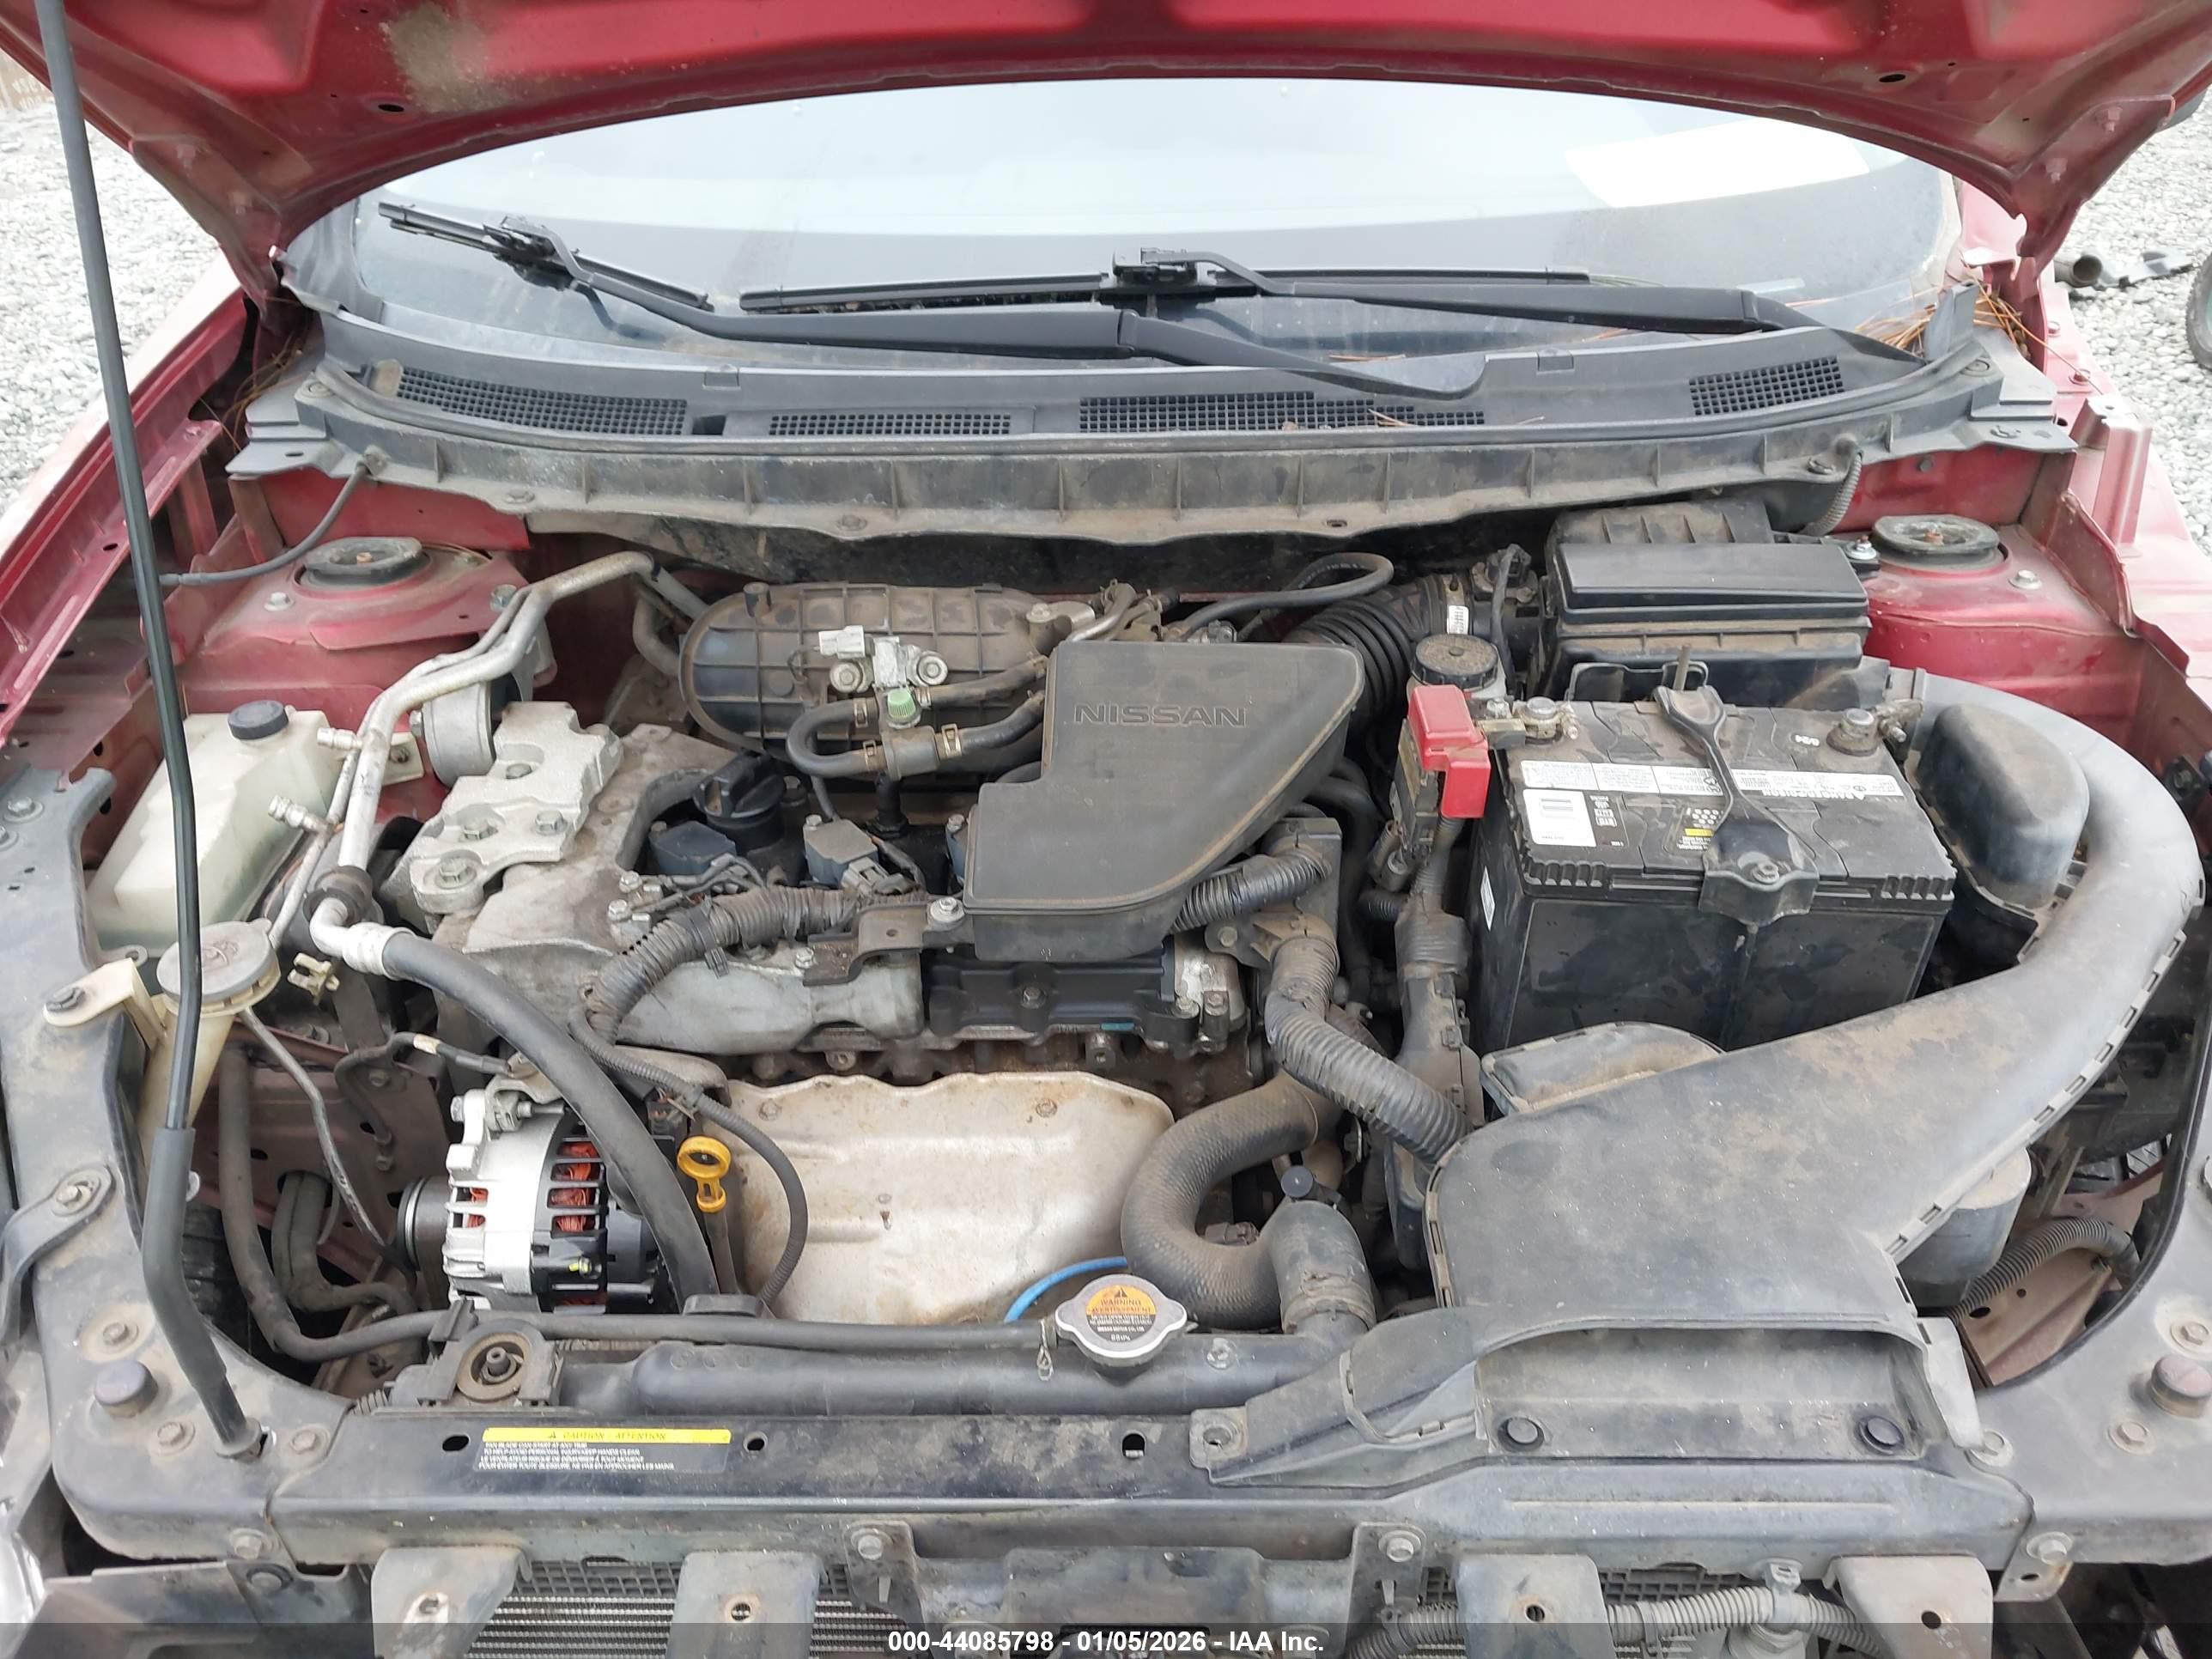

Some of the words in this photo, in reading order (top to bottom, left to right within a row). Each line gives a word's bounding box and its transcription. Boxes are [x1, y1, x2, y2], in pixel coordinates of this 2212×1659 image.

[1074, 704, 1247, 728] NISSAN
[1100, 1297, 1142, 1306] WARNING
[616, 1431, 666, 1440] ATTENTION
